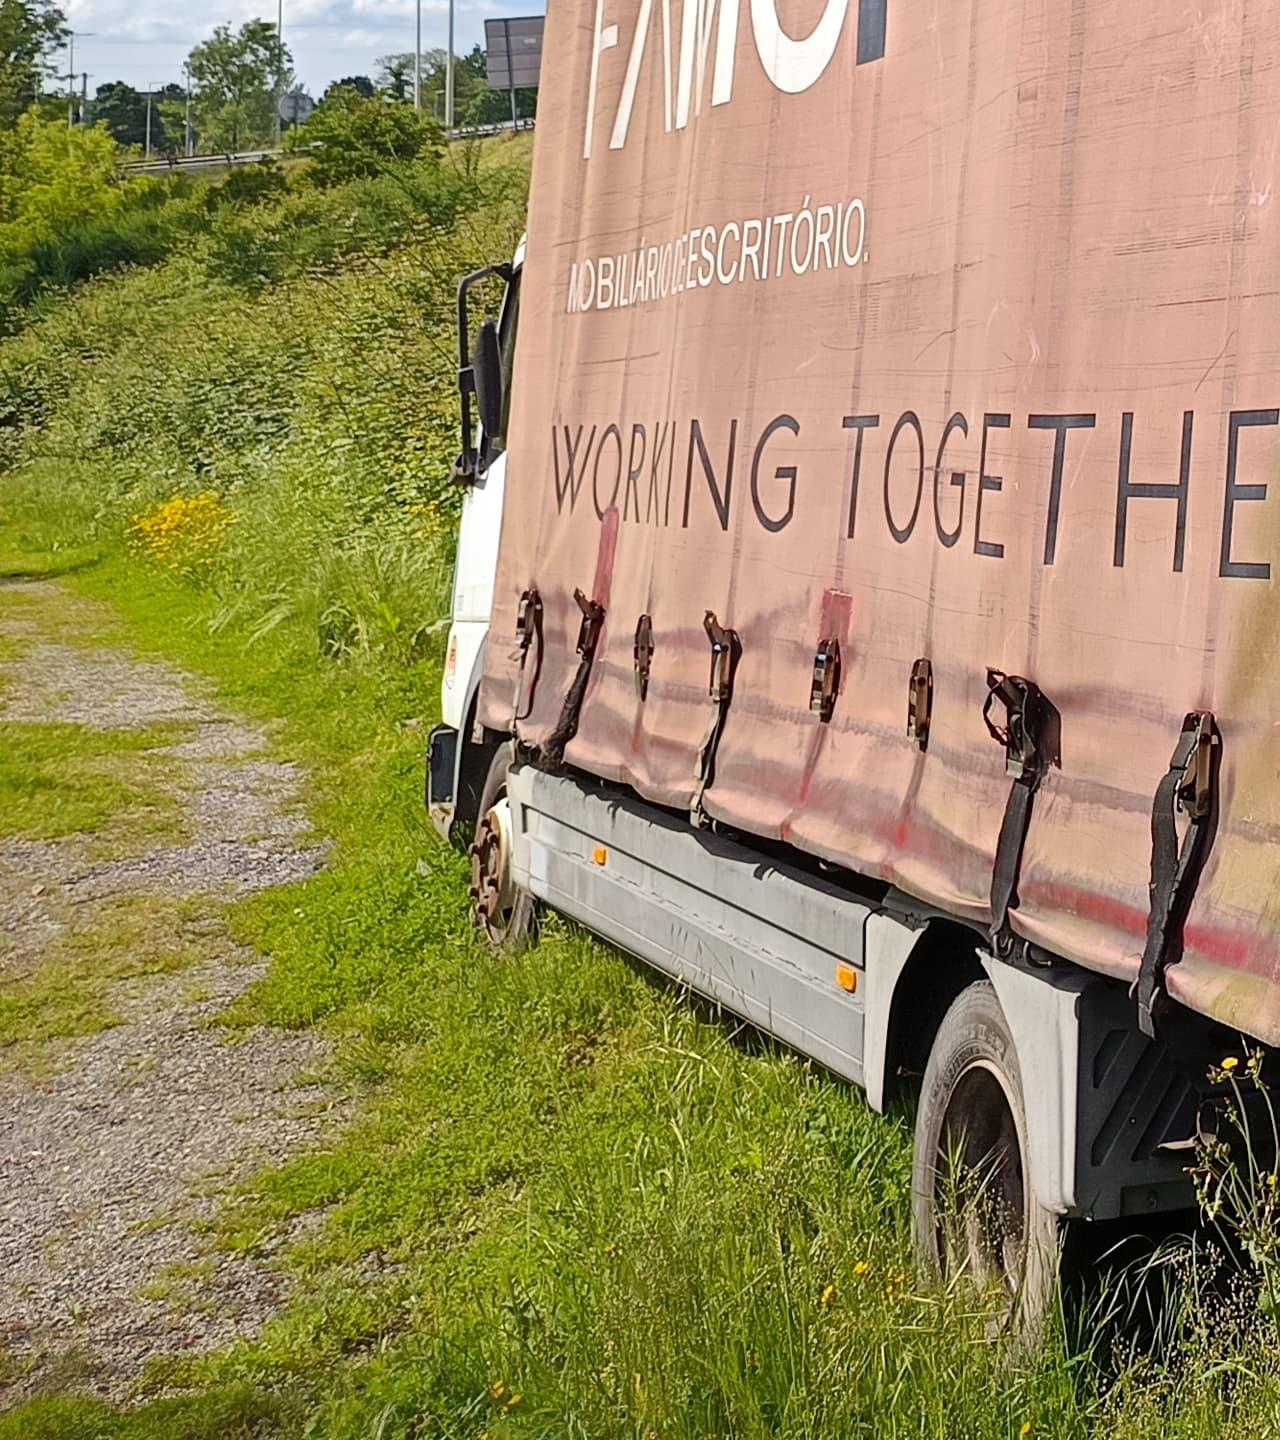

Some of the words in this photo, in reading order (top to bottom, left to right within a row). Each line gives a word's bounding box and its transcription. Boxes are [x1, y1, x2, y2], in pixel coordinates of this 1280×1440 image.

[566, 236, 673, 314] MOBILIÁRIO
[686, 193, 870, 290] ESCRITÓRIO.
[551, 413, 802, 534] WORKING
